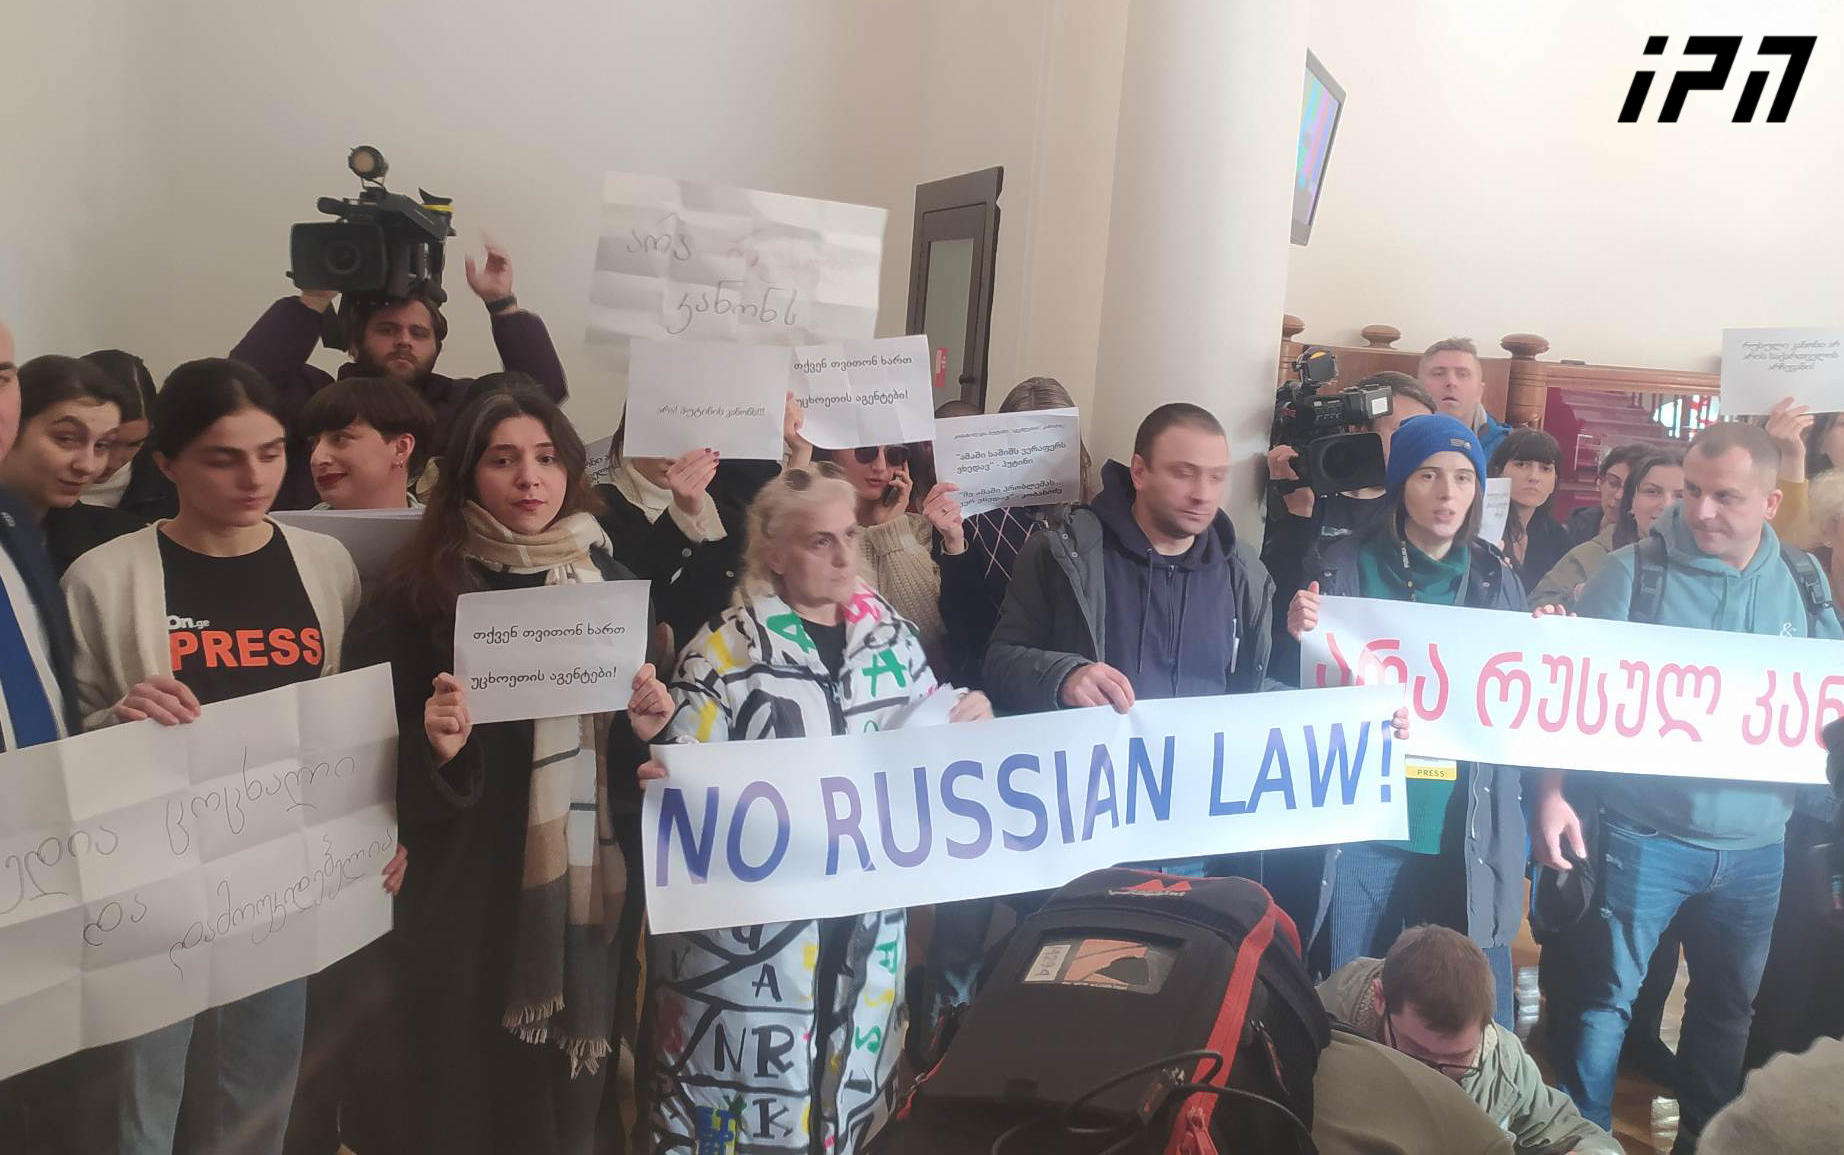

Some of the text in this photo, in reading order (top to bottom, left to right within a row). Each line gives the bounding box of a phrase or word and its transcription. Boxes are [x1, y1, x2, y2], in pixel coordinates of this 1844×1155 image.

[625, 212, 692, 262] არა
[666, 279, 797, 335] კანონს
[793, 354, 912, 374] თქვენ თვითონ ხართ
[855, 390, 909, 406] აგენტები!
[1002, 458, 1034, 469] პუტინი
[169, 627, 323, 671] PRESS
[473, 622, 625, 644] თქვენ თვითონ ხართ
[471, 666, 617, 691] უცხოეთის აგენტები!
[1477, 651, 1721, 743] რუსულ
[1416, 769, 1446, 779] PRESS
[166, 746, 354, 855] ცოცხალი
[655, 720, 1392, 887] NO RUSSIAN LAW!
[83, 899, 147, 947] და
